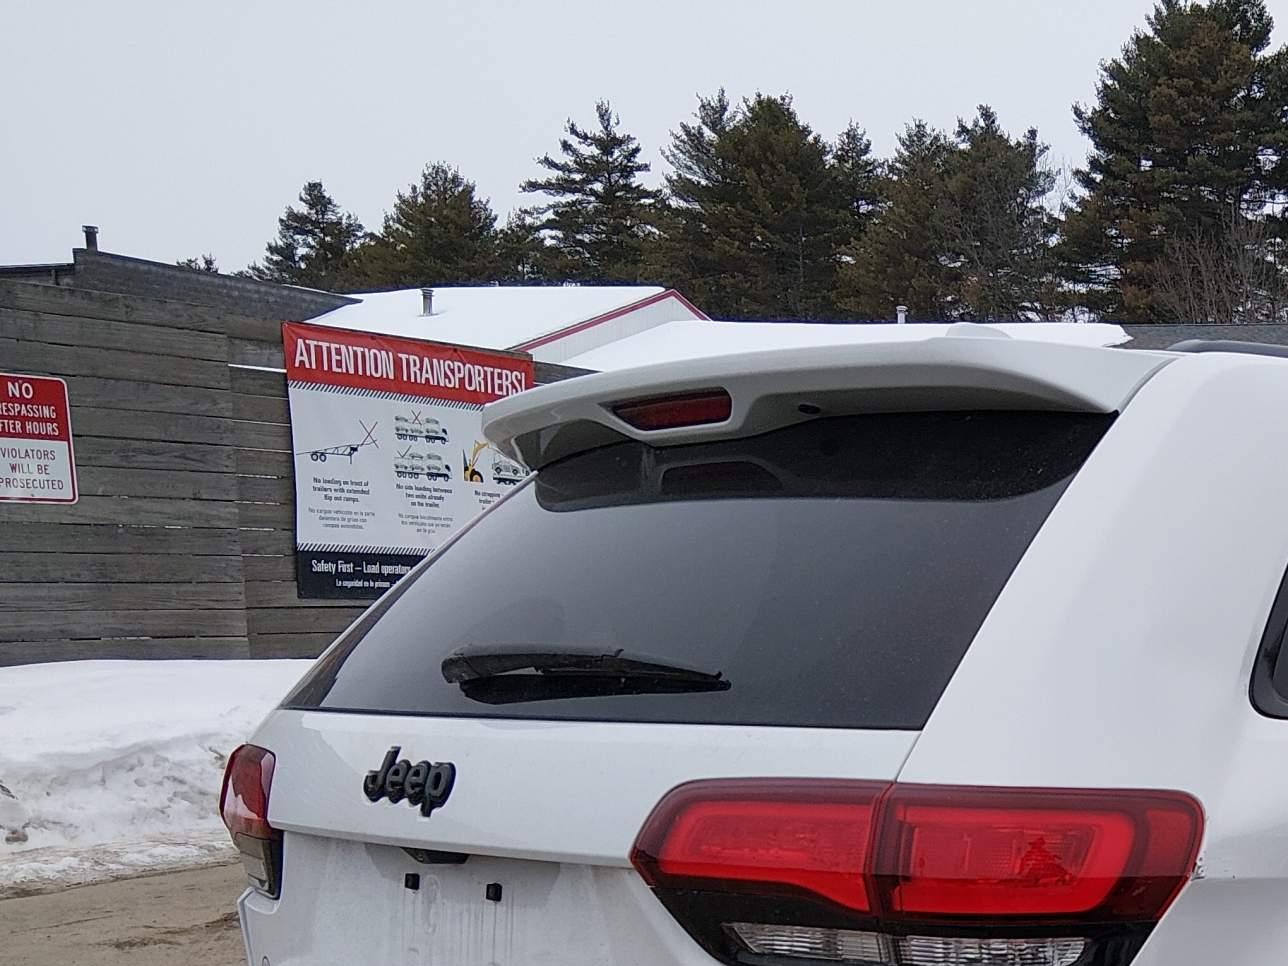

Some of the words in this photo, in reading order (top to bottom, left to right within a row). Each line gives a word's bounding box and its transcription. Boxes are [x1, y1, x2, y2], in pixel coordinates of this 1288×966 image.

[294, 338, 395, 380] ATTENTION
[8, 381, 34, 399] NO
[26, 420, 59, 436] HOURS
[0, 447, 56, 461] VIOLATORS
[9, 462, 33, 474] WILL
[37, 463, 50, 475] BE
[0, 477, 64, 490] PROSECUTED
[311, 559, 337, 575] Safety
[363, 561, 380, 574] Load
[363, 746, 456, 818] Jeep
